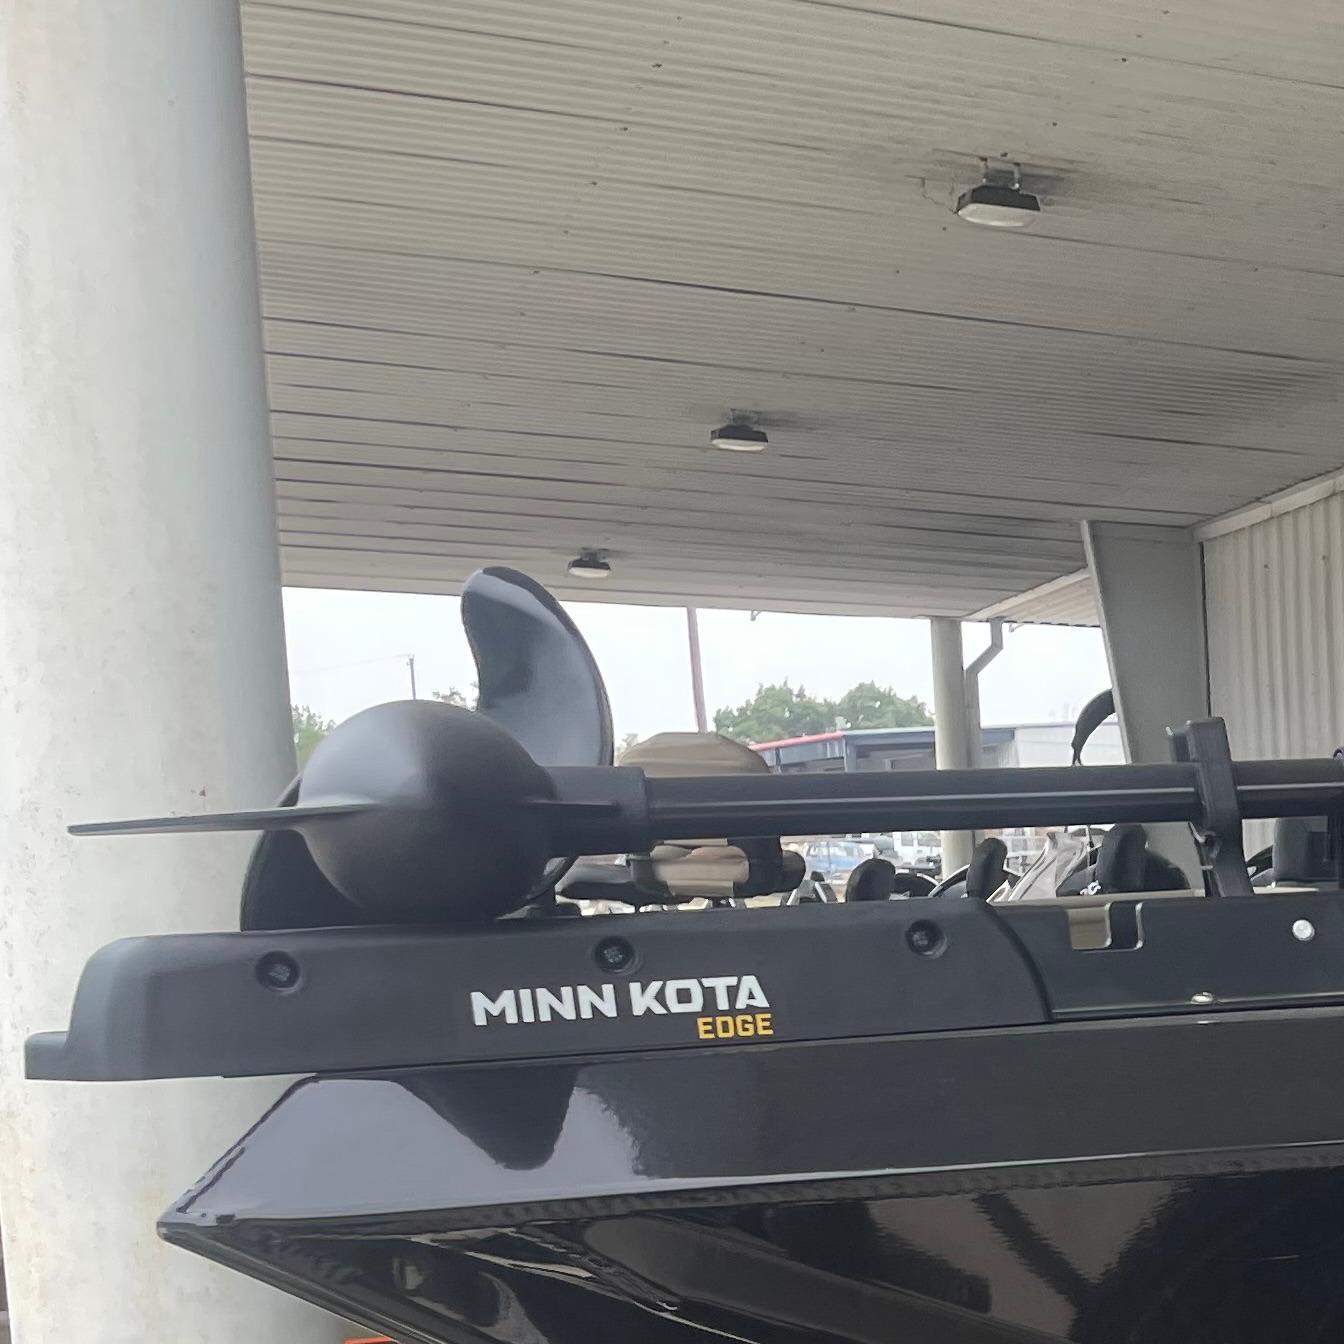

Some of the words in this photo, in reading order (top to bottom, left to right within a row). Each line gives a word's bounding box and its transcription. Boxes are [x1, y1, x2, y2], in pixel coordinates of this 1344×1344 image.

[470, 983, 618, 1026] MINN
[629, 975, 770, 1017] KOTA
[697, 1013, 774, 1039] EDGE
